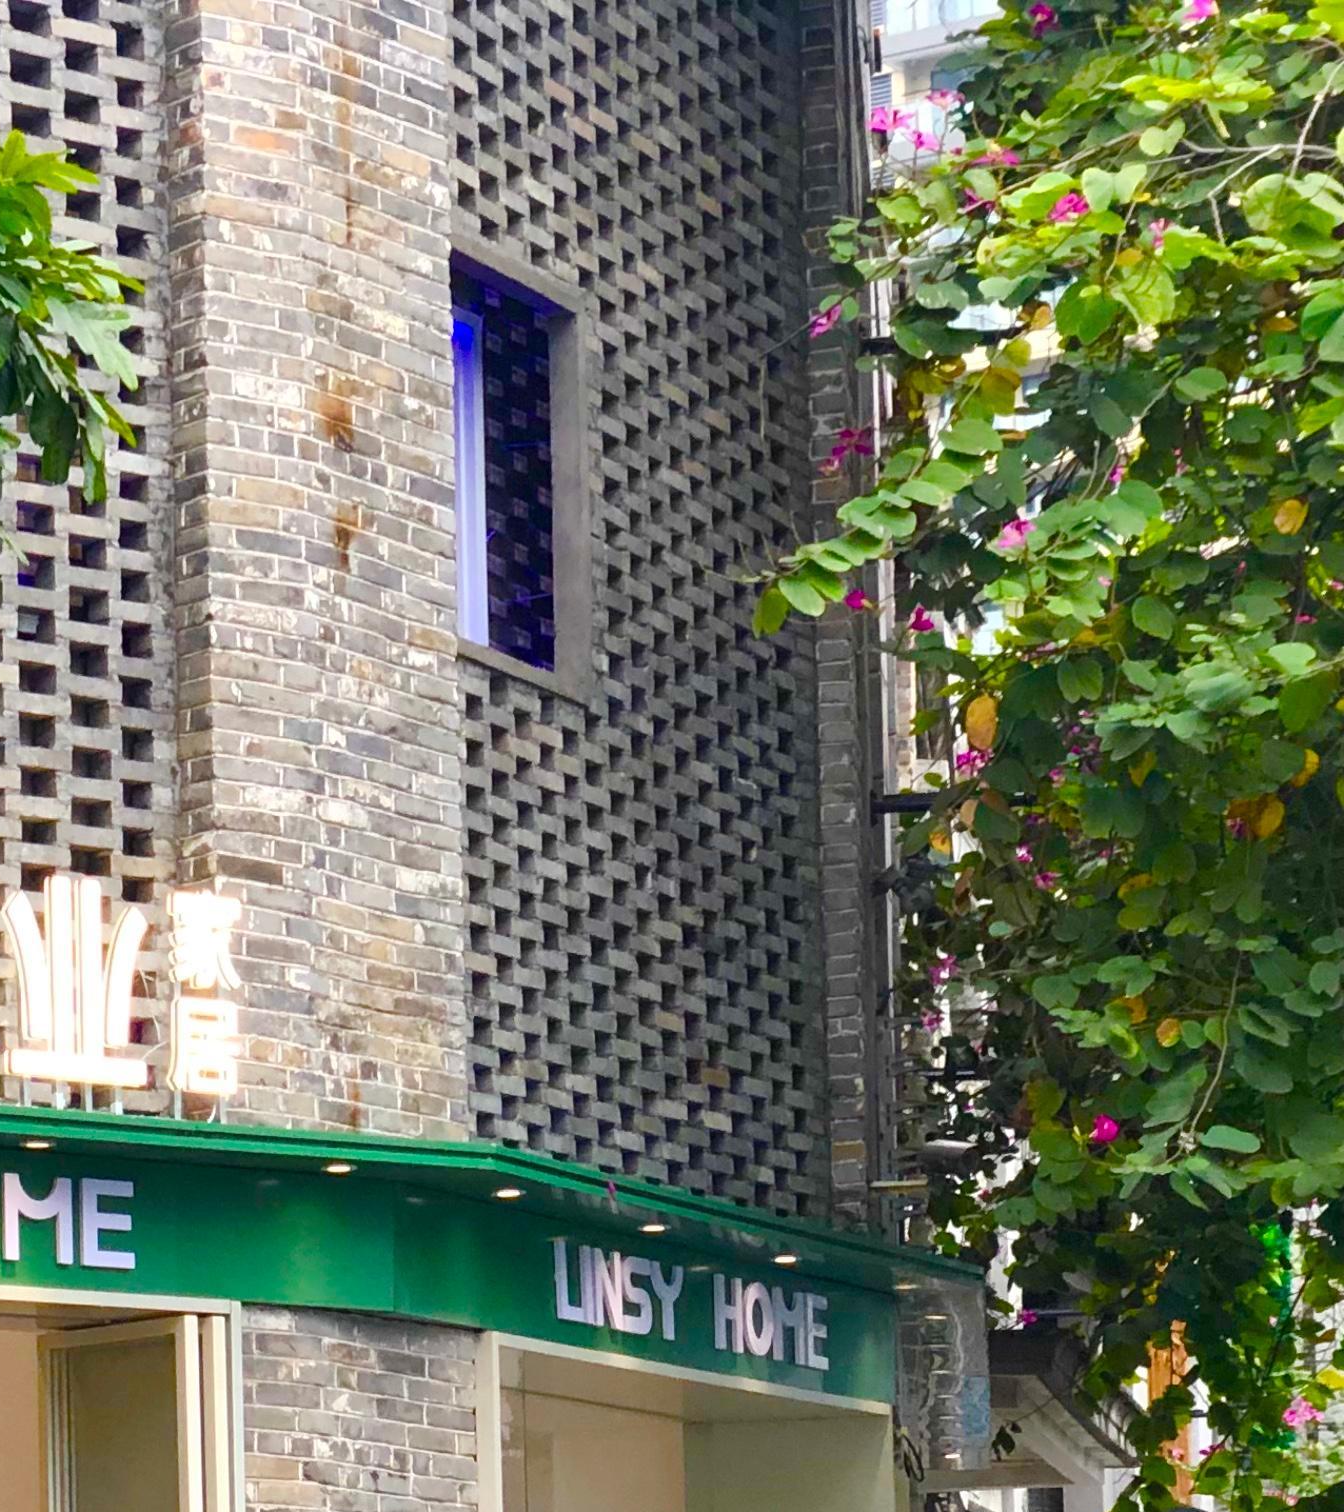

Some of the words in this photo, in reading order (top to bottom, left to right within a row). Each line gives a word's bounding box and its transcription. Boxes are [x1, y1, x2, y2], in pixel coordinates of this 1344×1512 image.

[166, 889, 243, 1094] 家居
[553, 1237, 683, 1341] LINSY
[713, 1273, 829, 1371] HOME
